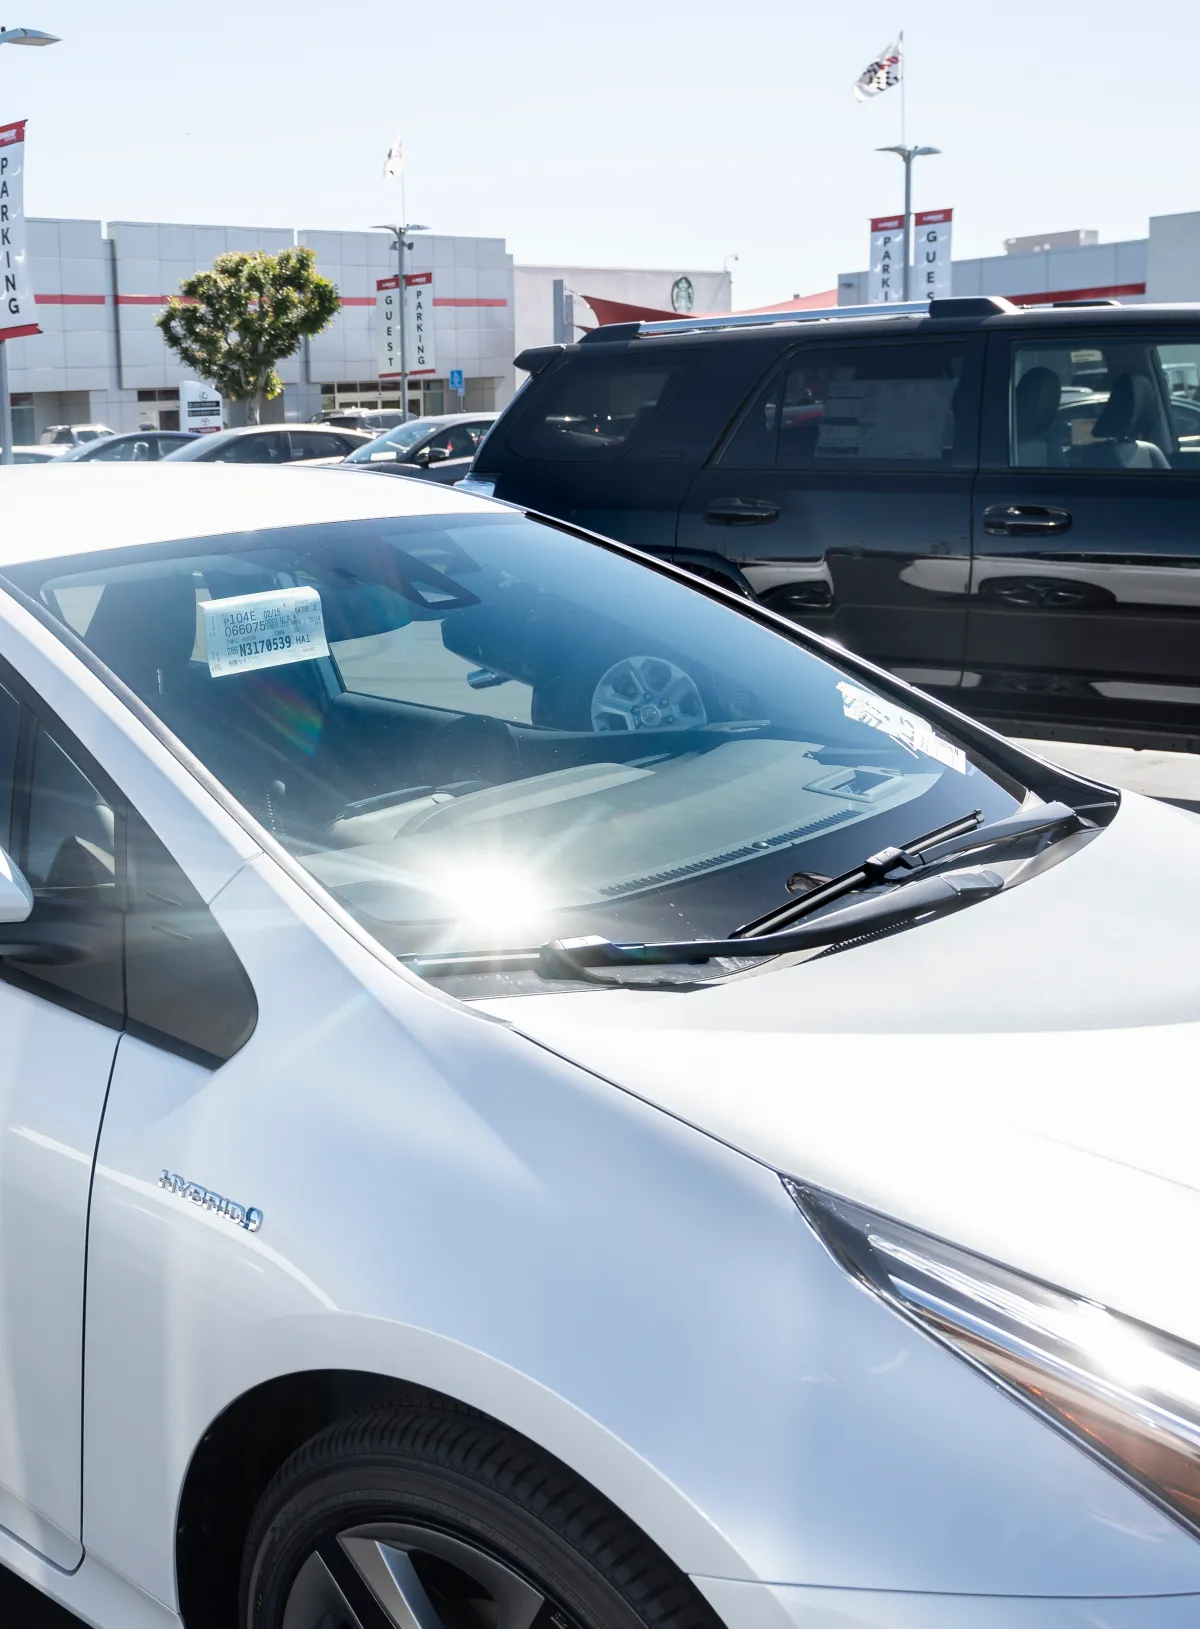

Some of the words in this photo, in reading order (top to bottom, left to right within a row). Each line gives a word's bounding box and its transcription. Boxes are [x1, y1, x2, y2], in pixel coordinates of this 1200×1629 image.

[0, 157, 20, 315] PARKING
[881, 236, 892, 301] PARKI
[926, 231, 937, 300] GUES
[385, 295, 394, 366] GUEST
[416, 290, 425, 365] PARKING
[224, 621, 266, 637] 066075
[239, 635, 292, 657] N3170539
[295, 634, 311, 645] HA1
[158, 1169, 246, 1226] HYBRID
